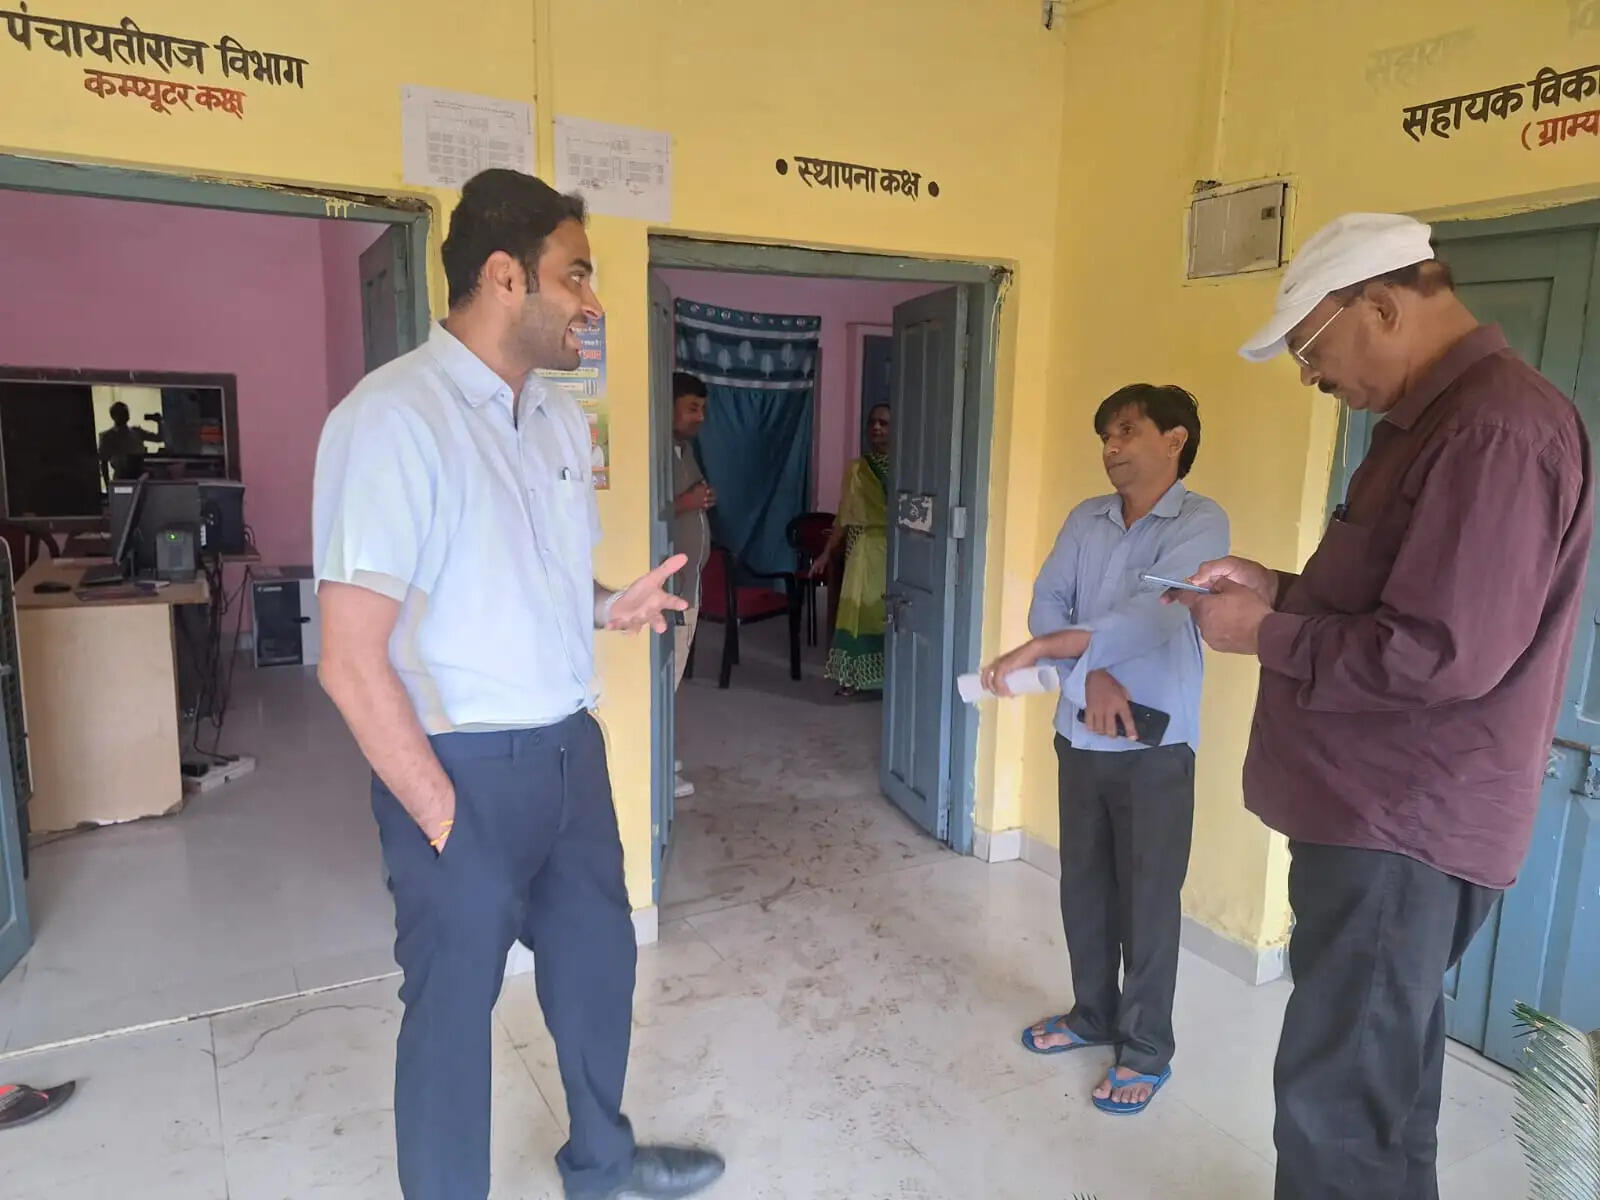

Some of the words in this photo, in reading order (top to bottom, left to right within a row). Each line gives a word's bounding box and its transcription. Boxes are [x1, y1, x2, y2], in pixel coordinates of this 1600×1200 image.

[0, 1, 209, 74] पंचायतीराज
[214, 35, 309, 89] विभाग
[195, 85, 247, 120] कक्ष
[1403, 83, 1525, 142] सहायक
[1527, 66, 1600, 112] विक
[794, 156, 879, 193] स्थापना
[879, 168, 922, 201] कक्ष
